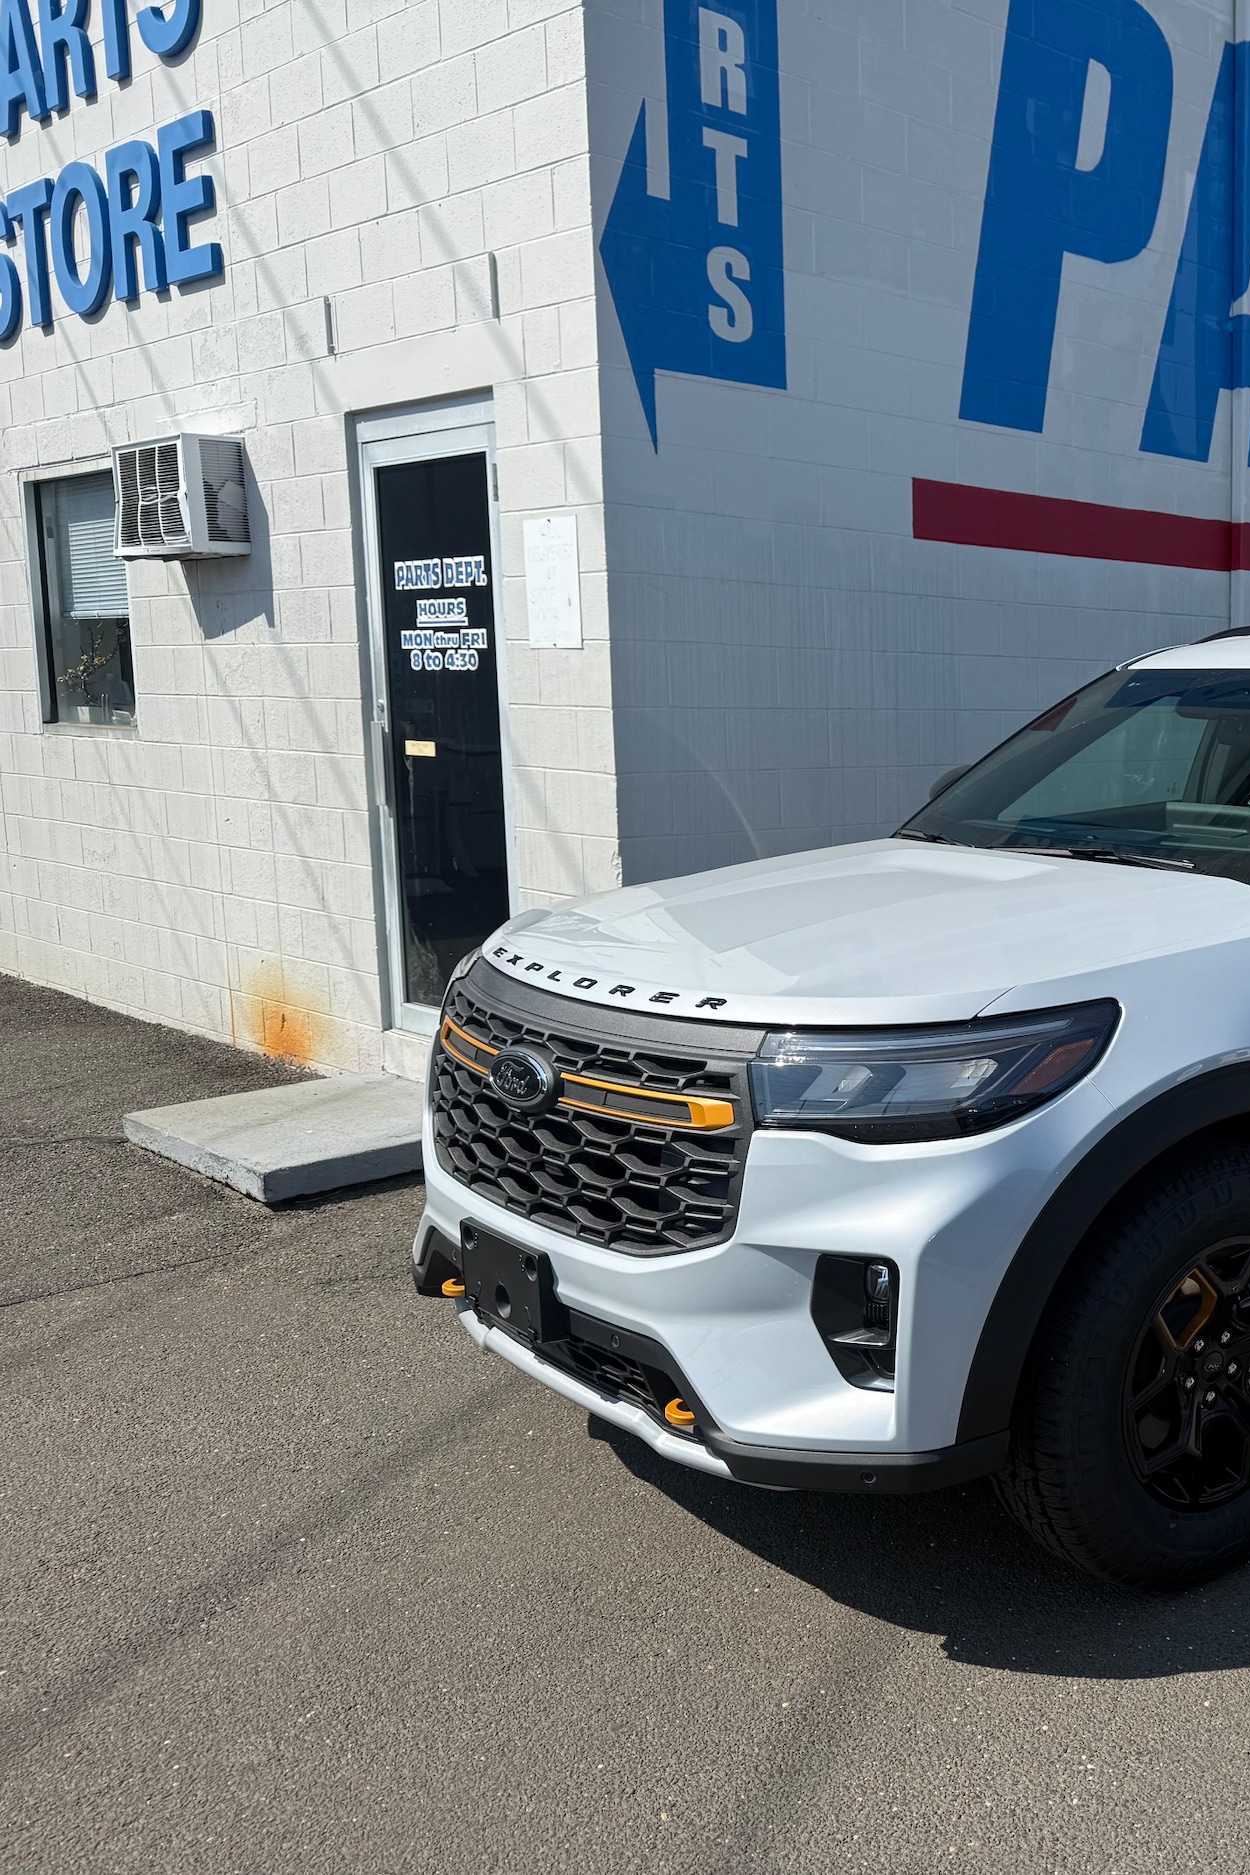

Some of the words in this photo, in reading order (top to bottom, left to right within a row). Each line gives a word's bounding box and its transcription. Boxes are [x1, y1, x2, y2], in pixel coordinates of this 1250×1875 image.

[395, 560, 441, 588] PARTS
[443, 557, 487, 587] DEPT.
[418, 600, 465, 617] HOURS
[402, 631, 433, 648] MON
[434, 633, 459, 647] thru
[461, 630, 486, 647] FRI
[412, 652, 421, 669] 8
[425, 652, 442, 669] to
[446, 651, 478, 669] 4:30
[492, 946, 728, 1010] EXPLORER
[496, 1060, 531, 1095] Ford
